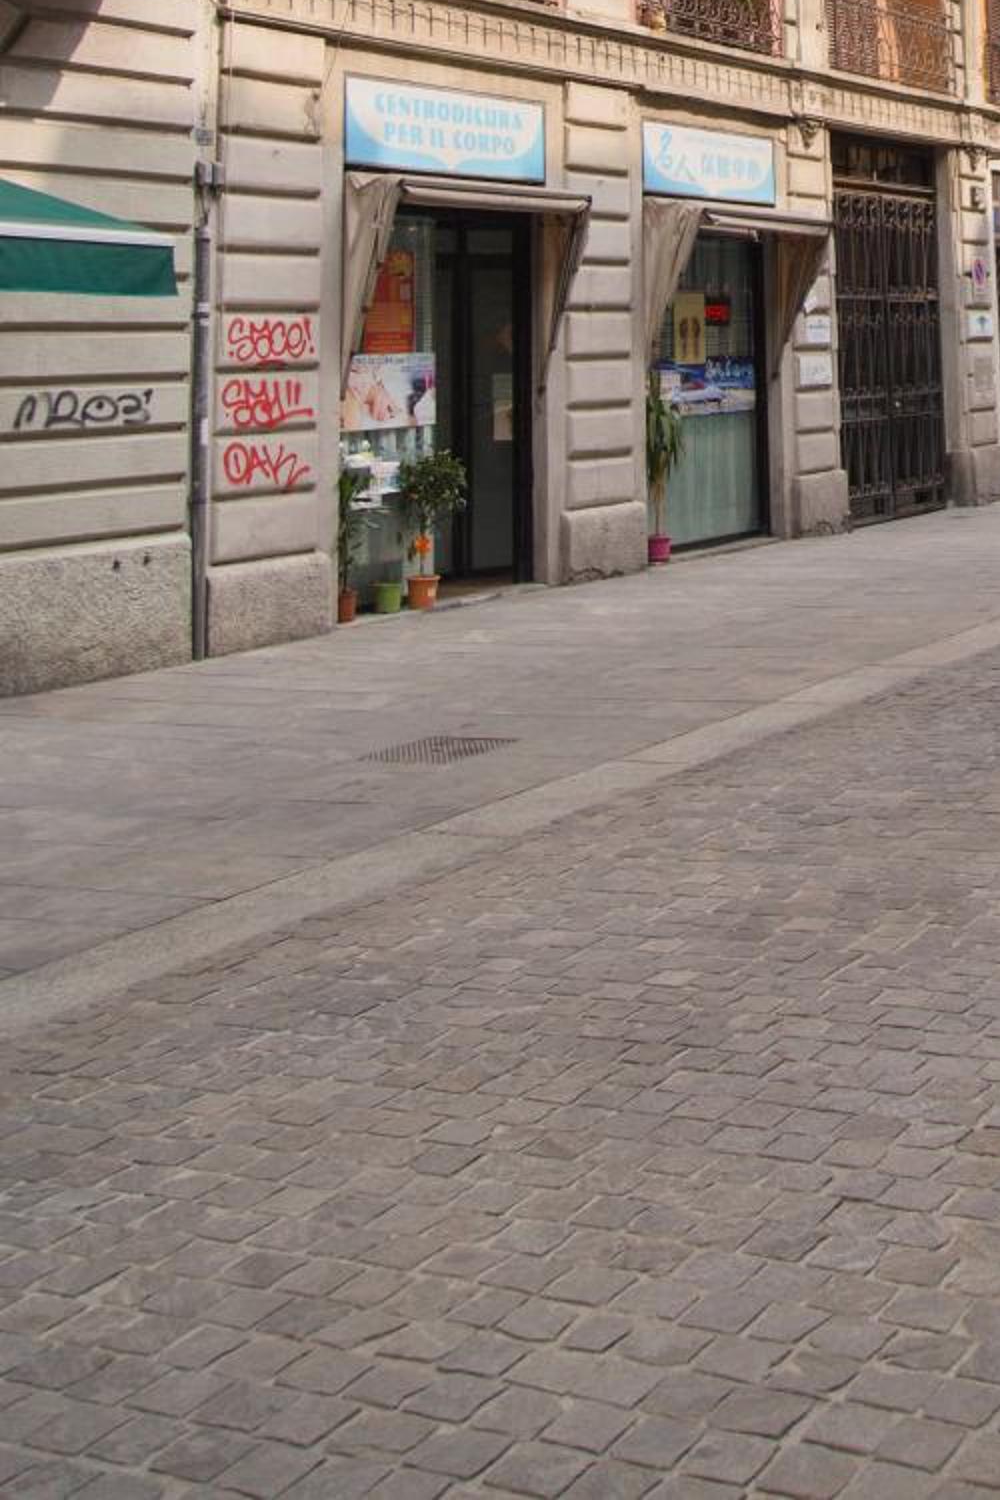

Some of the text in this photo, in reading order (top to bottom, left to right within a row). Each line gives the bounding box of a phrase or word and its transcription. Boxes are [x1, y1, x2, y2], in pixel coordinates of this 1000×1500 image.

[383, 121, 515, 155] PER IL CORPO
